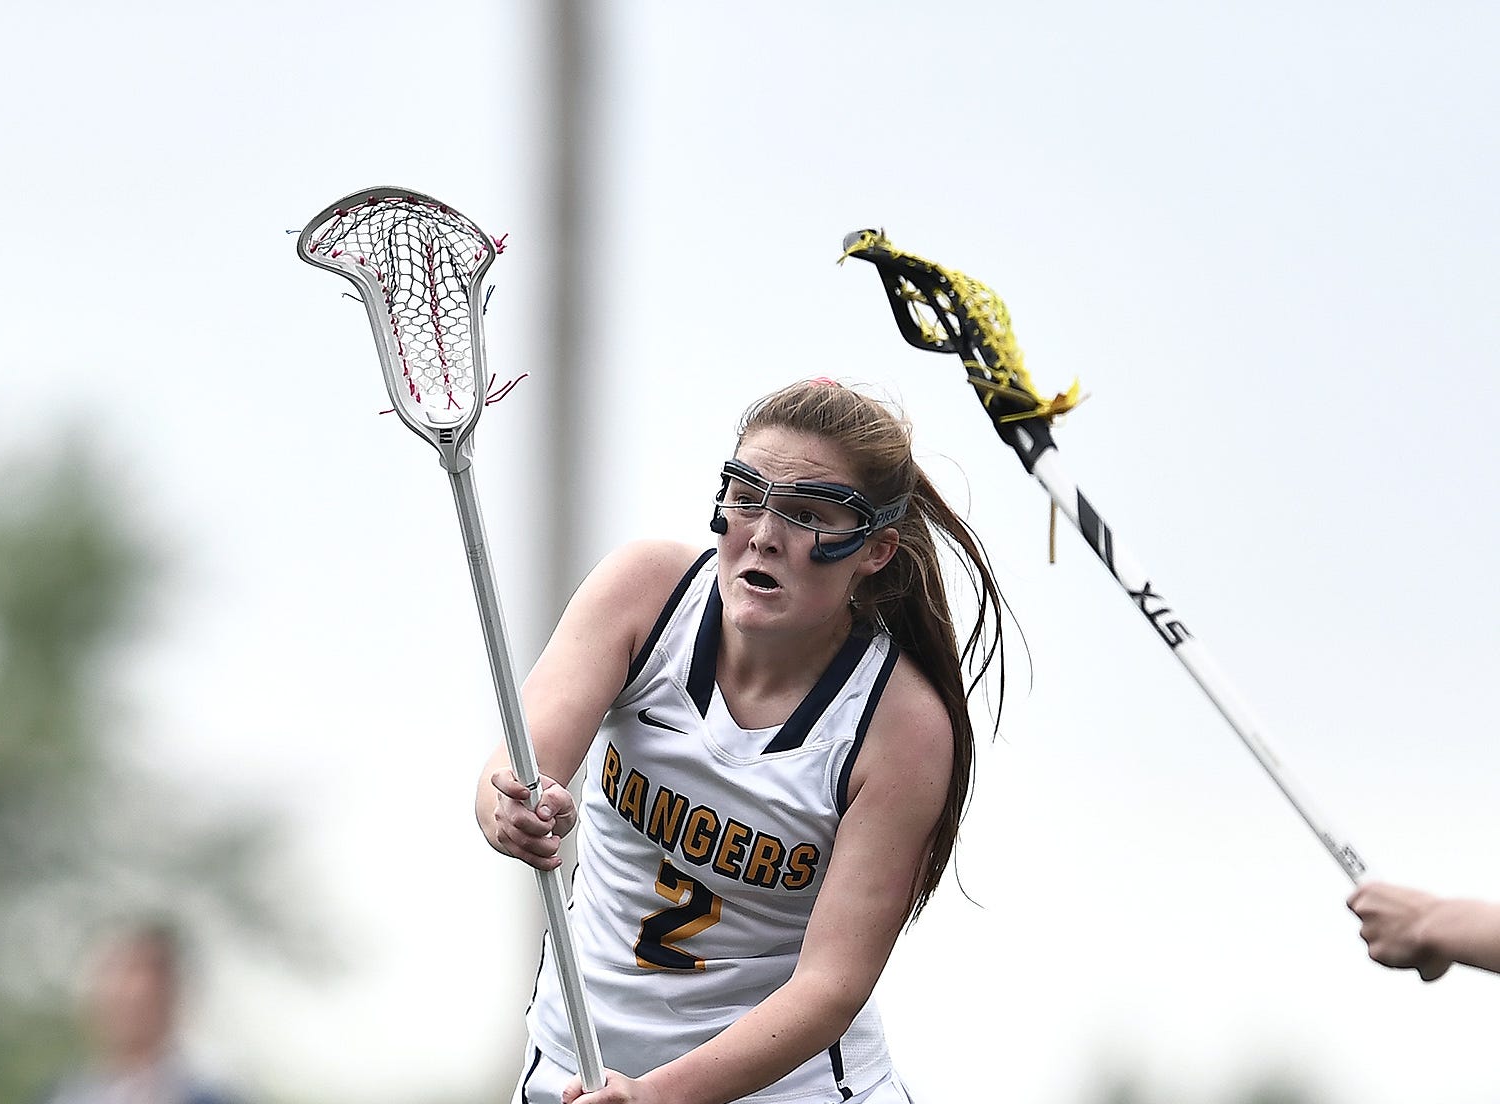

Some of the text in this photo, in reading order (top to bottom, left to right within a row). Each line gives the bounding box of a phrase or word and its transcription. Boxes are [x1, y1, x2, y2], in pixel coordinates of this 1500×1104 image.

[1127, 581, 1197, 649] STX
[601, 741, 821, 891] RANGERS
[632, 858, 723, 971] 2
